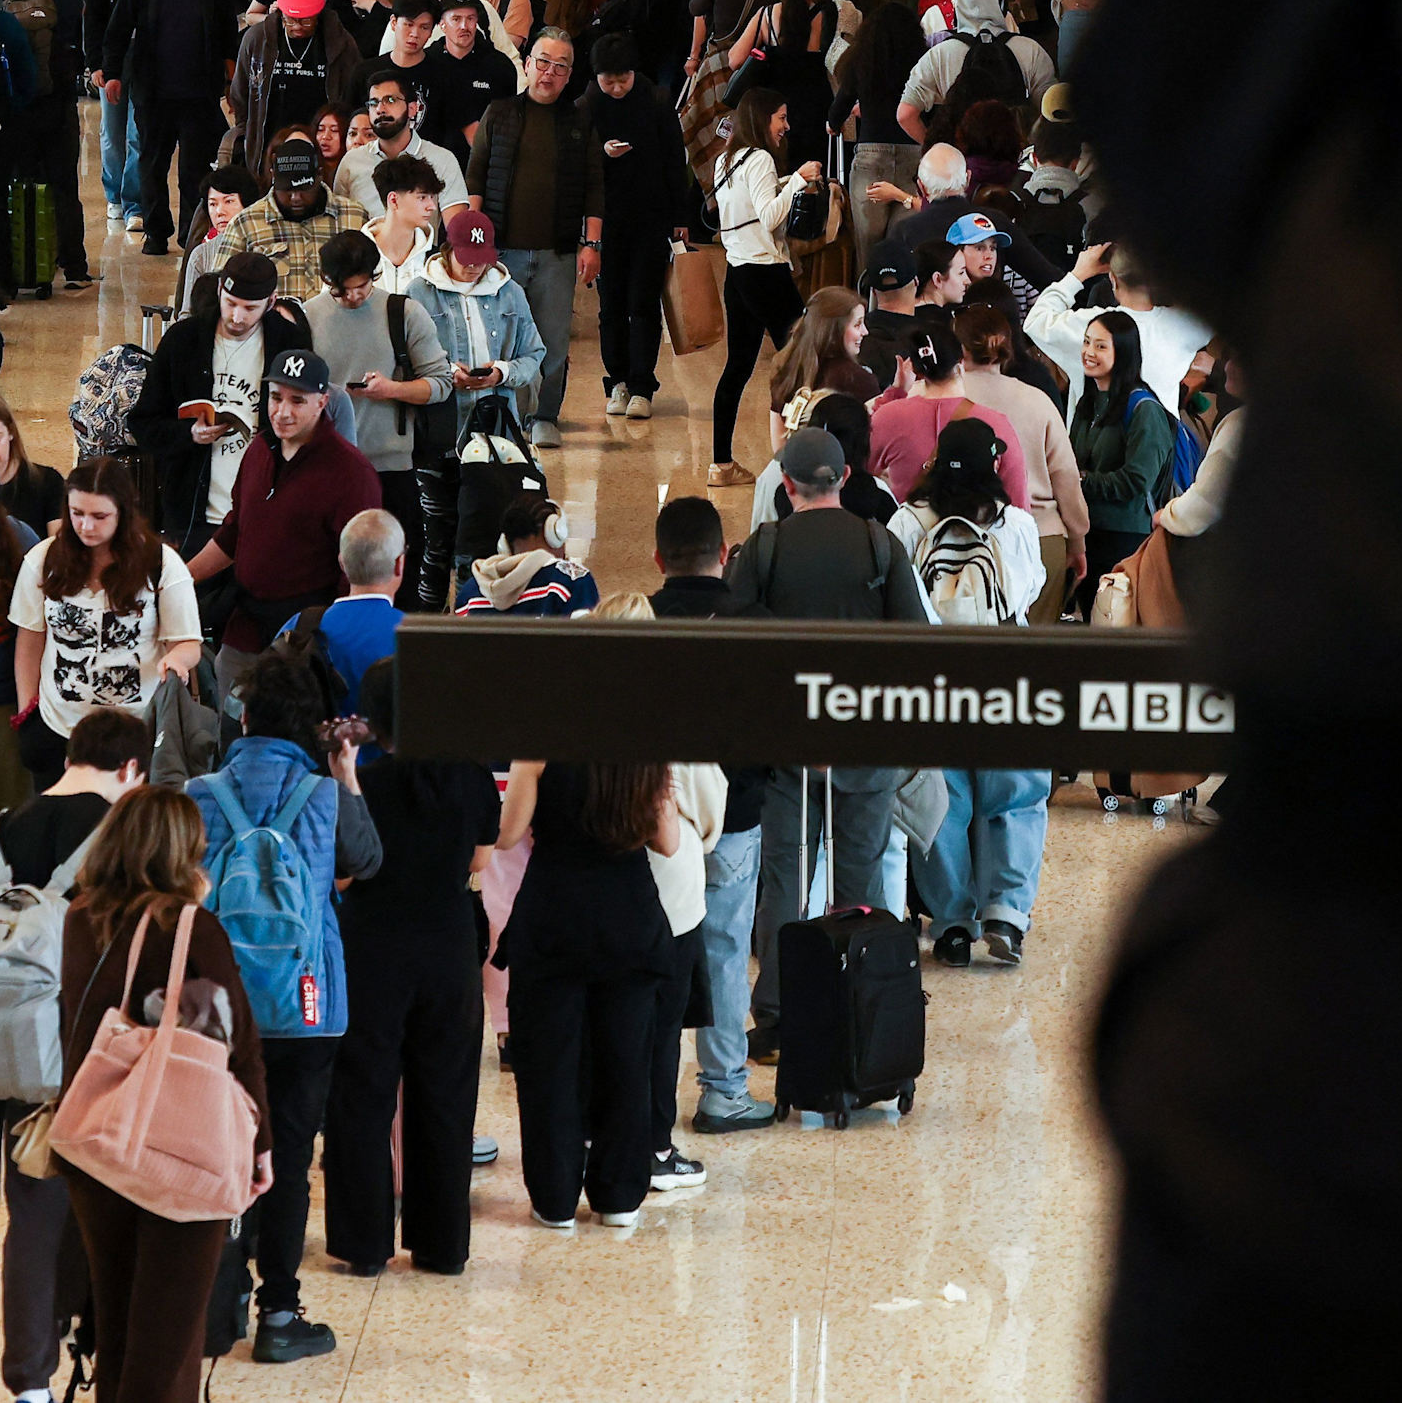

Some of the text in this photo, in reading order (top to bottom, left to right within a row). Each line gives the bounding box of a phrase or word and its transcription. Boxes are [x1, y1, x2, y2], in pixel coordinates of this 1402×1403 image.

[470, 227, 485, 244] NY
[282, 355, 306, 378] NY
[795, 672, 1065, 726] Terminals
